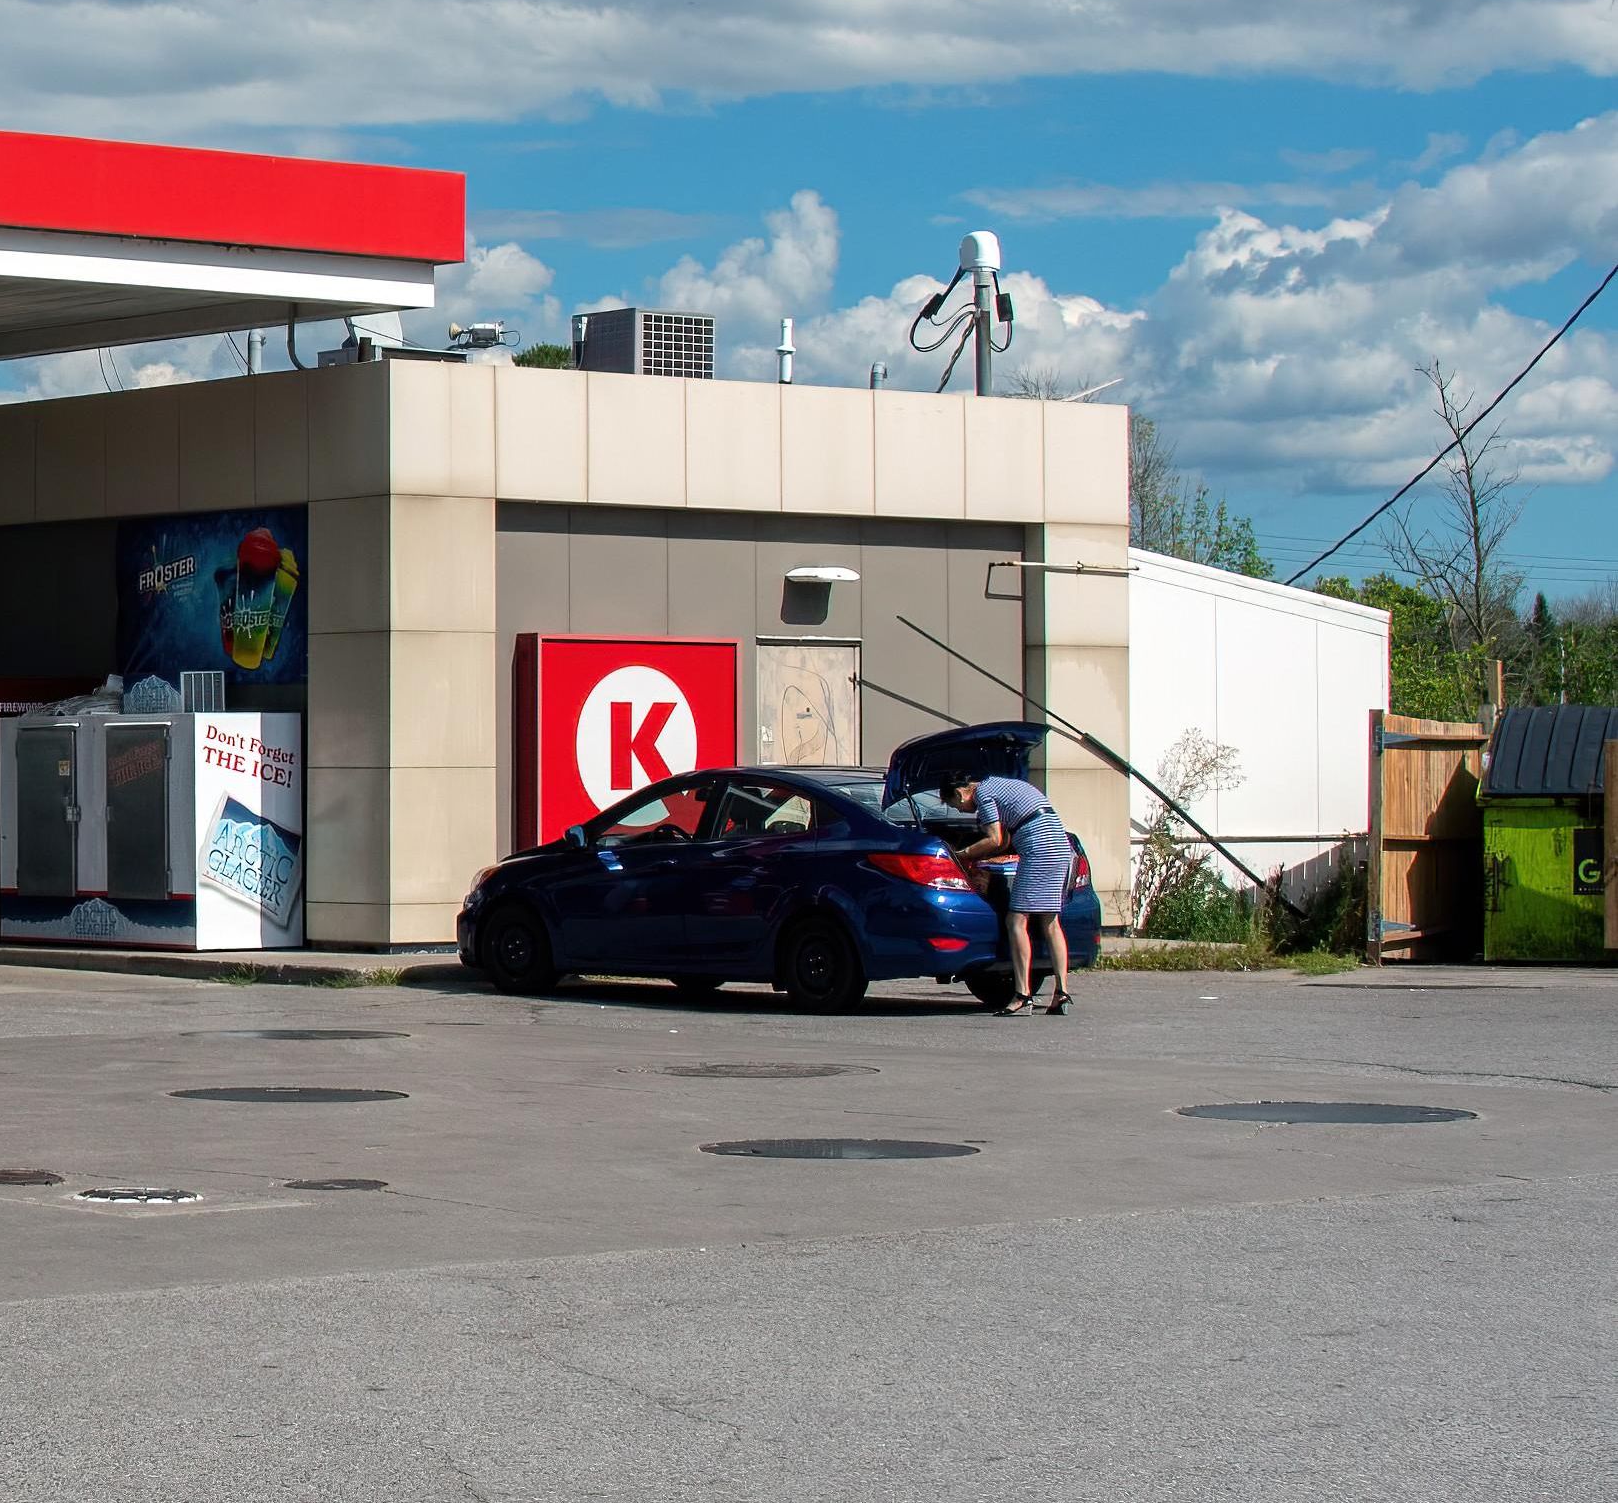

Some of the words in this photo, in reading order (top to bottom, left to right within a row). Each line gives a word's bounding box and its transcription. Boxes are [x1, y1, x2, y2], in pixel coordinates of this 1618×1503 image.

[139, 556, 195, 591] FROSTER
[202, 745, 246, 774] THE
[250, 759, 294, 788] ICE!
[205, 724, 246, 750] Don't
[250, 737, 295, 766] Forget
[611, 702, 678, 790] K
[207, 848, 282, 907] GLACIER
[212, 822, 295, 886] ARCTIC
